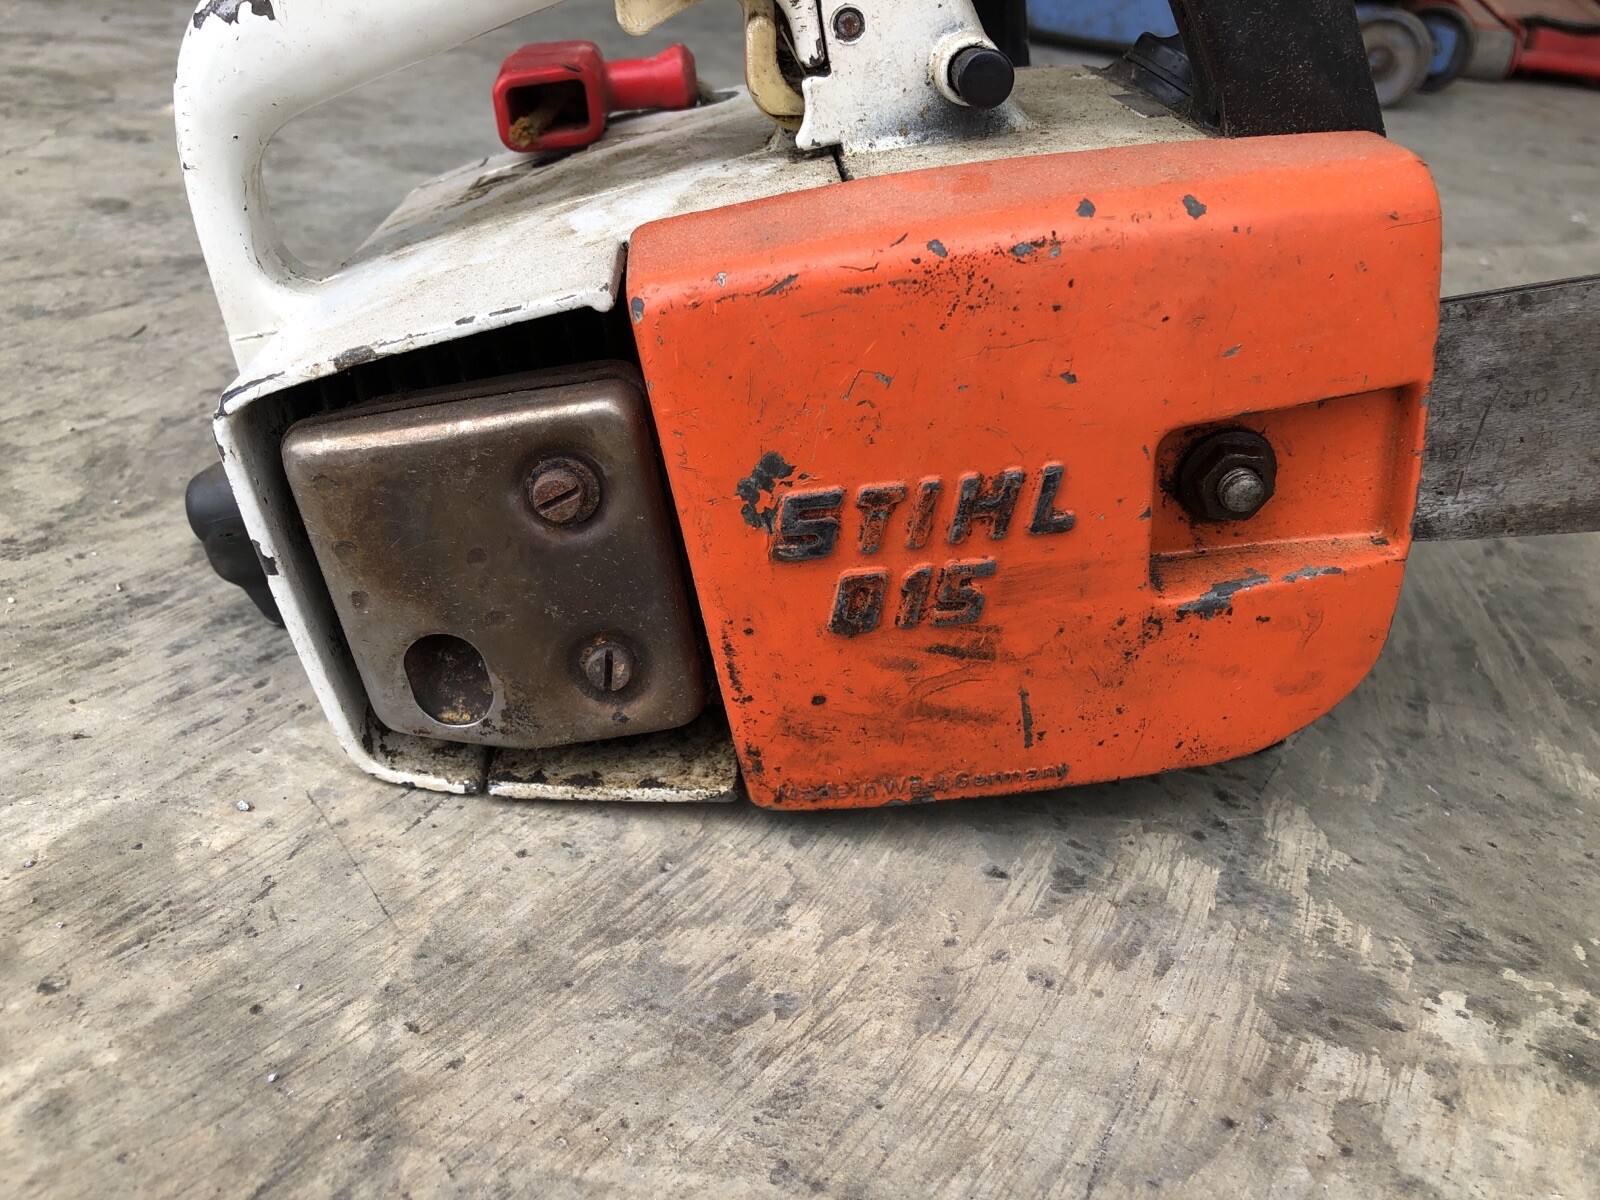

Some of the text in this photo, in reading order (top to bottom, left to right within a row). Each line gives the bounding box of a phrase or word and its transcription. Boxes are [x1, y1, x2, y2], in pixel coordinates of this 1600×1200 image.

[769, 461, 1076, 562] STIHL
[827, 556, 997, 637] 015
[953, 763, 1070, 789] Germany
